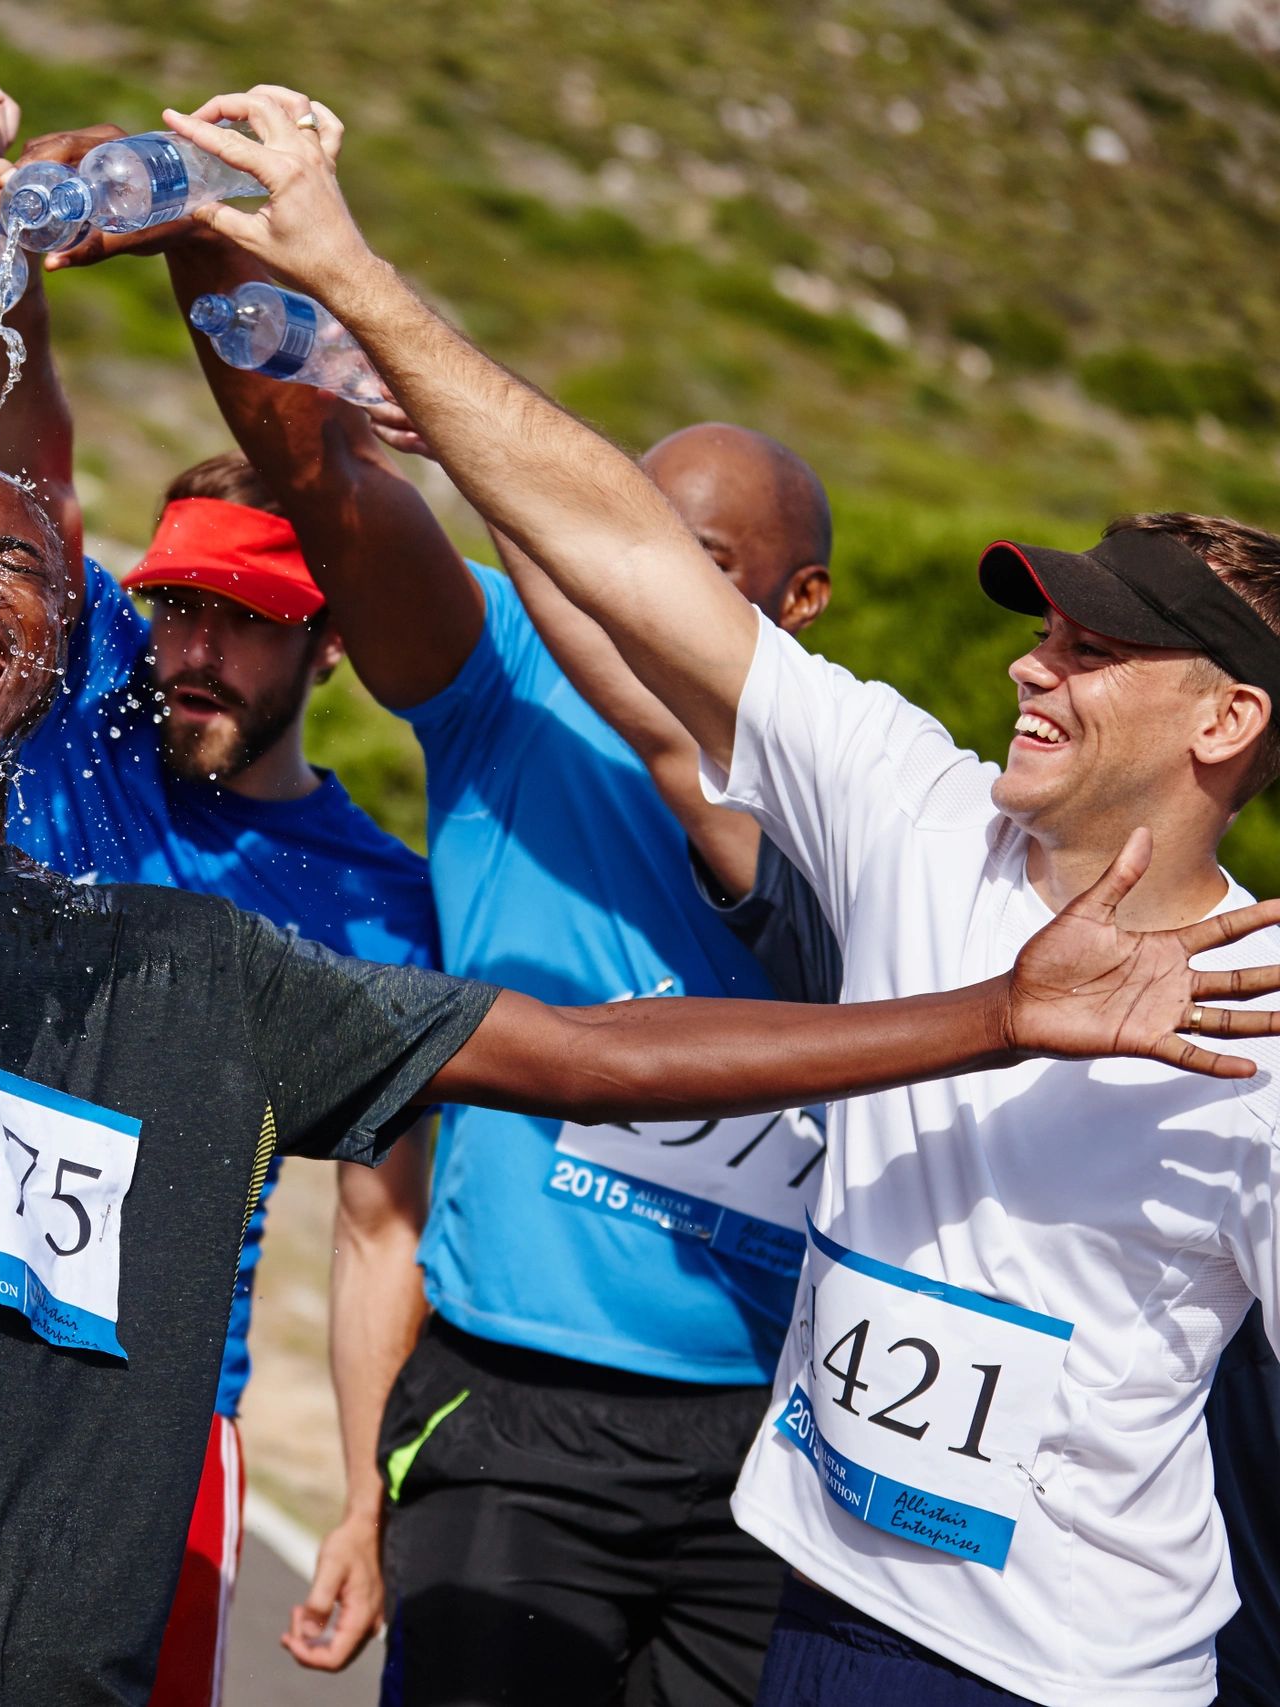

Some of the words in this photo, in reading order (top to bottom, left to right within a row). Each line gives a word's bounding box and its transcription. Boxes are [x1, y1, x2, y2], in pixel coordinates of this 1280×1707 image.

[550, 1160, 630, 1211] 2015
[635, 1189, 692, 1217] ALLSTAR
[824, 1468, 861, 1507] RATHON
[893, 1490, 967, 1529] Allistair
[890, 1509, 980, 1554] Enterprises
